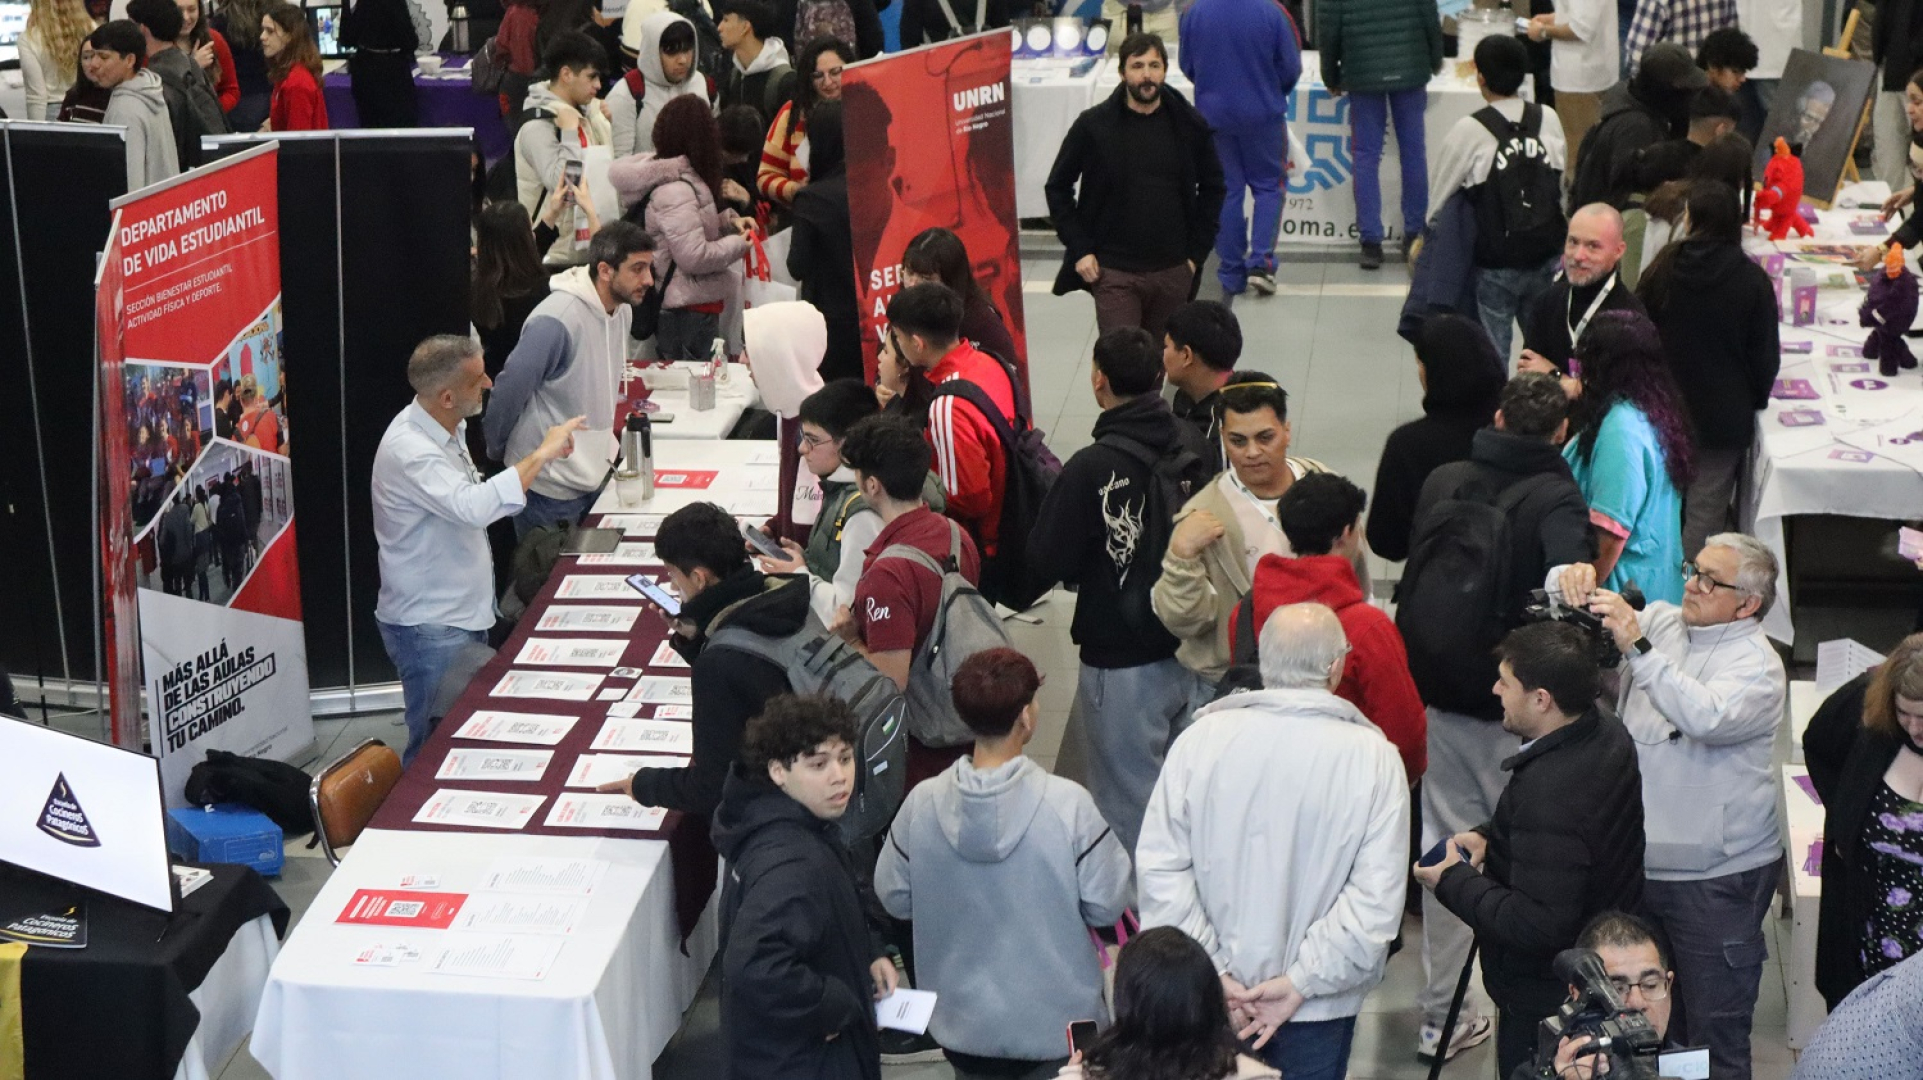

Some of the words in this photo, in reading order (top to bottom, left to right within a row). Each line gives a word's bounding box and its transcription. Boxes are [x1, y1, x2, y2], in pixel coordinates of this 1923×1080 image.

[953, 81, 1005, 111] UNRN
[121, 190, 228, 247] DEPARTAMENTO
[1289, 198, 1314, 210] 972
[123, 253, 142, 277] DE
[144, 240, 178, 268] VIDA
[181, 206, 265, 255] ESTUDIANTIL
[1283, 218, 1402, 239] oma.eu.
[126, 294, 156, 315] SECCIÓN
[156, 279, 192, 303] BIENESTAR
[193, 263, 233, 288] ESTUDIANTIL
[127, 306, 162, 329] ACTIVIDAD
[163, 298, 186, 314] FÍSICA
[185, 295, 191, 305] Y
[866, 597, 891, 622] Ren
[162, 661, 193, 693] MÁS
[196, 637, 229, 674] ALLÁ
[164, 689, 182, 712] DE
[184, 671, 209, 700] LAS
[213, 646, 254, 684] AULAS
[167, 656, 274, 731] CONSTRUYENDO
[167, 730, 187, 753] TU
[189, 698, 245, 741] CAMINO.
[49, 804, 84, 823] Cocineros
[23, 917, 79, 931] Cocineros
